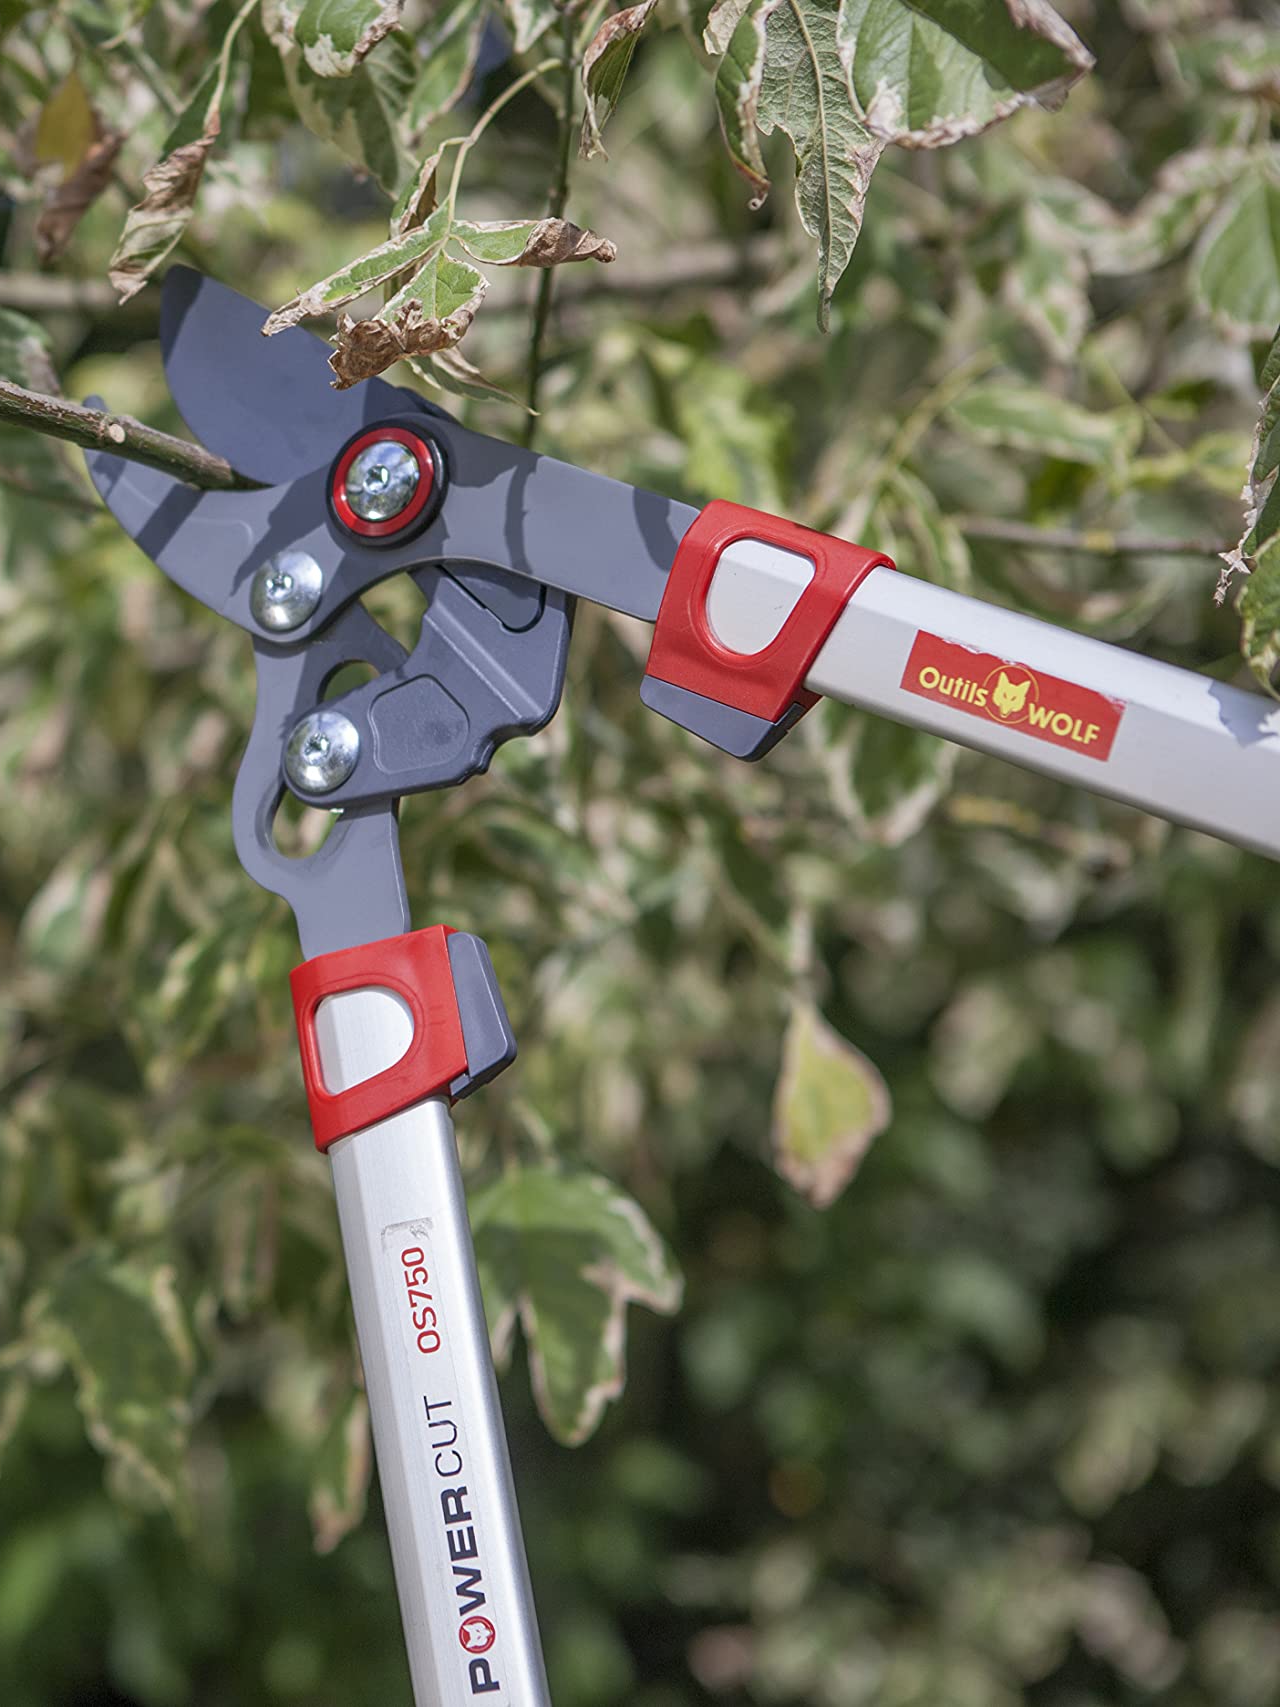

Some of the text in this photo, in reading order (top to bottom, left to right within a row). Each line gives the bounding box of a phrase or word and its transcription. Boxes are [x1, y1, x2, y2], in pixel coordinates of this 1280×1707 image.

[919, 666, 1100, 744] Outils WOLF
[401, 1247, 441, 1354] OS750
[423, 1395, 500, 1694] POWER CUT
